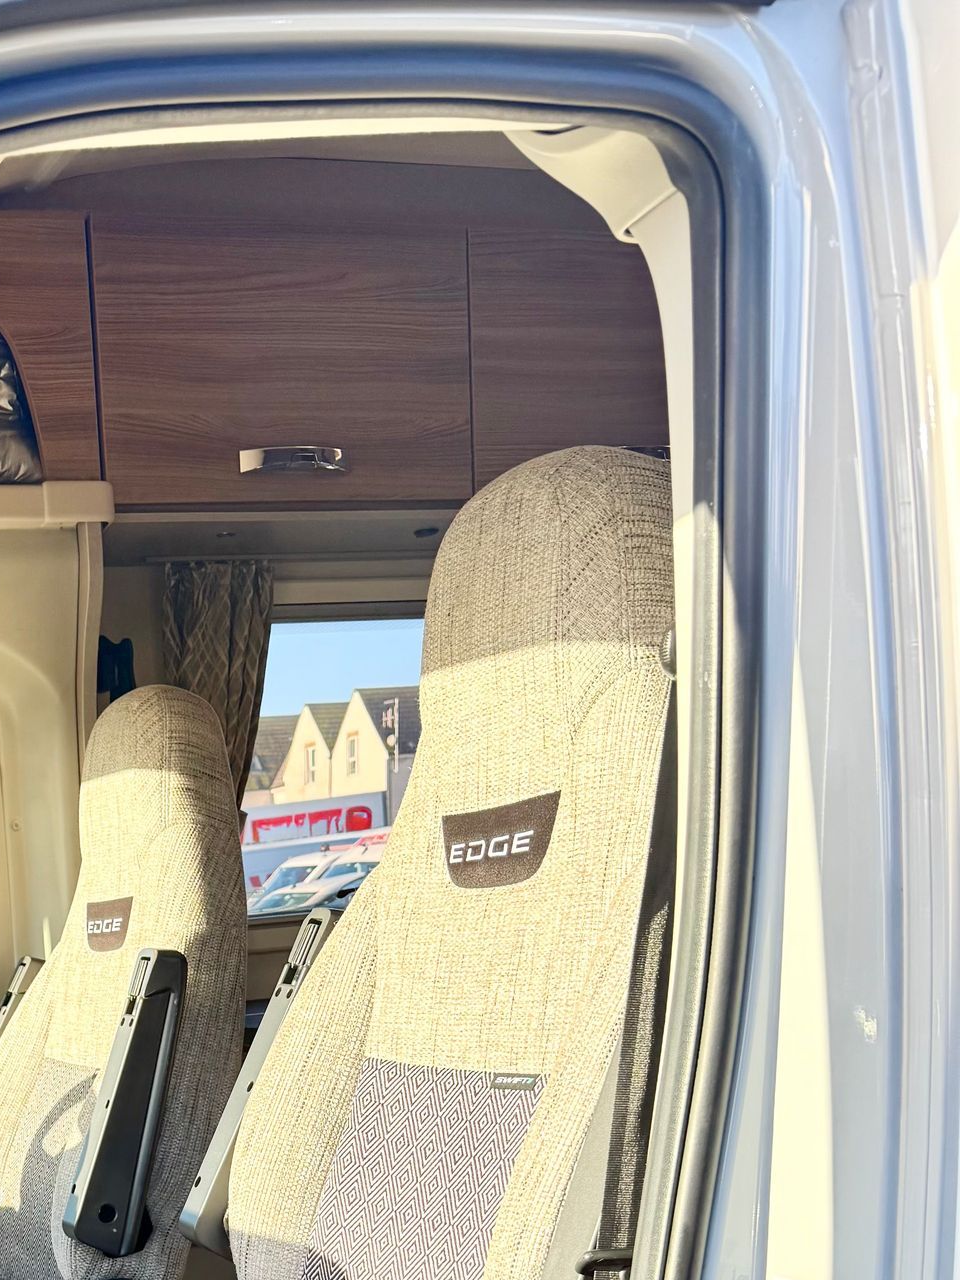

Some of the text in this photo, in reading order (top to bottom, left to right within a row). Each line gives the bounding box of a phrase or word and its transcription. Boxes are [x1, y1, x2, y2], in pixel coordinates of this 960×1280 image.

[449, 830, 534, 864] EDGE
[87, 918, 123, 934] EDGE
[495, 1076, 528, 1084] SWIFT
